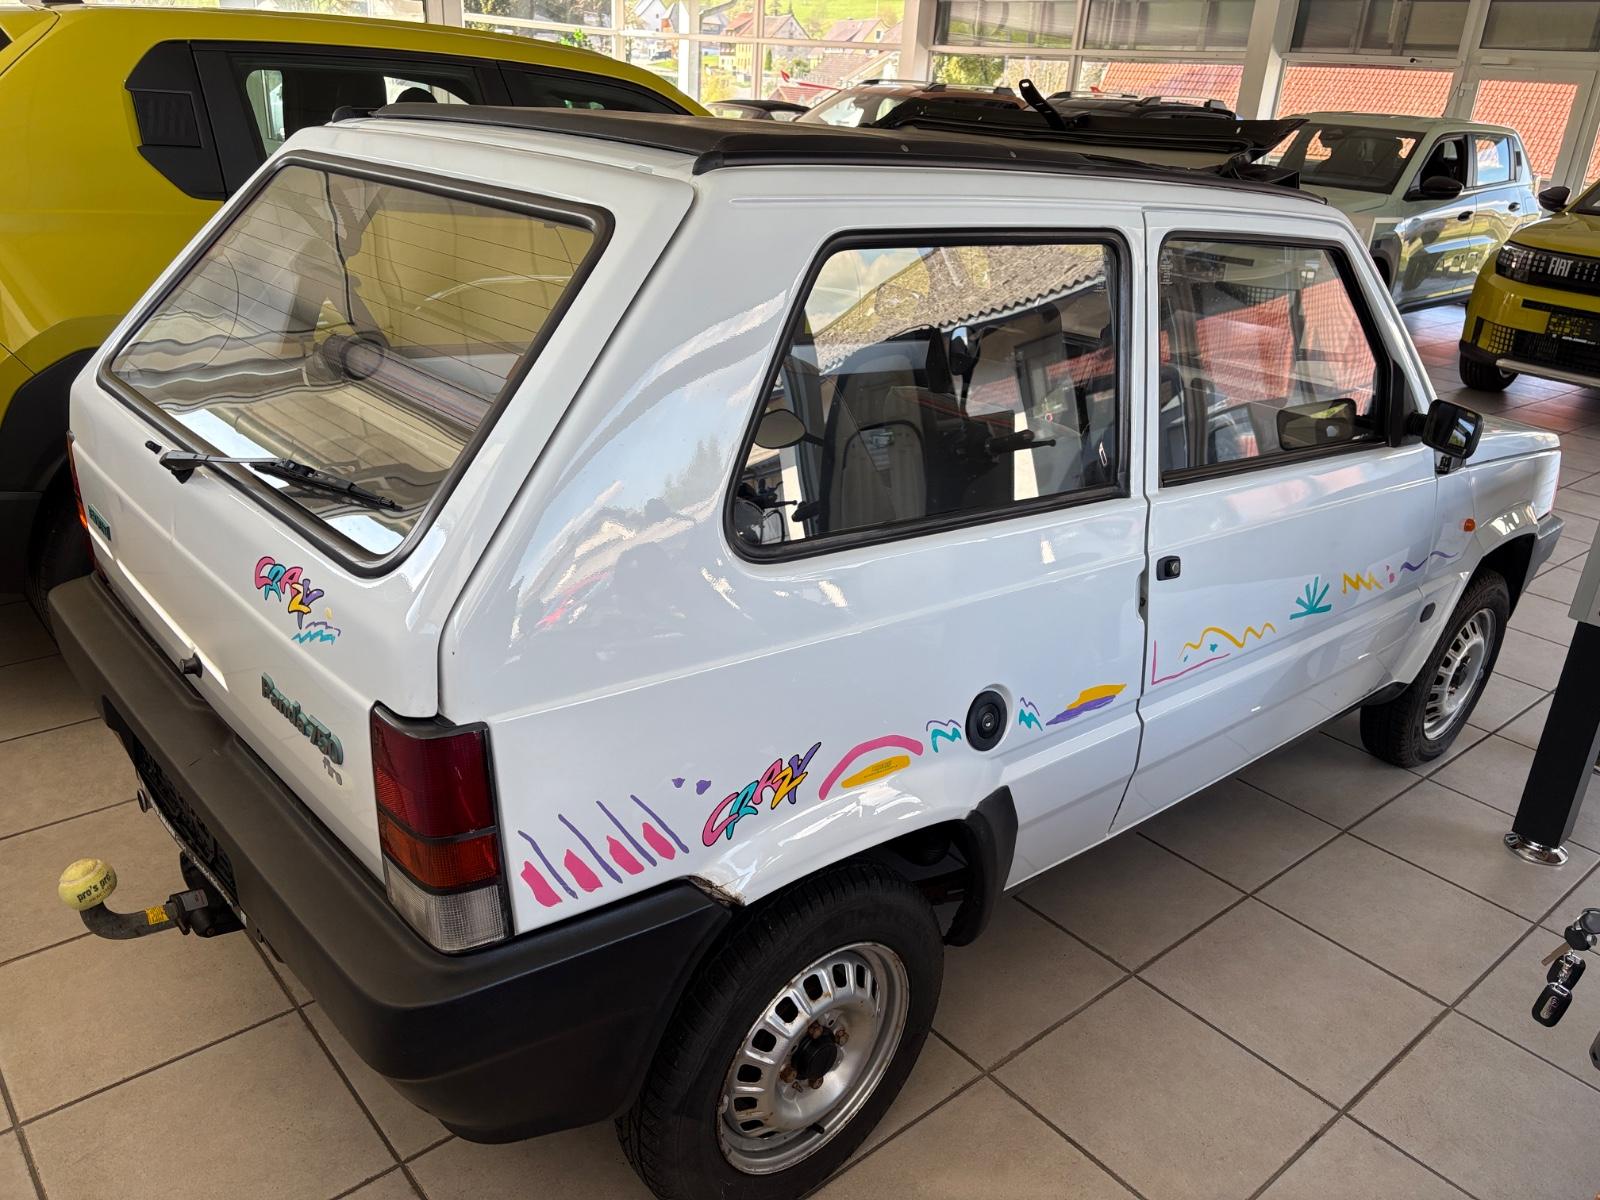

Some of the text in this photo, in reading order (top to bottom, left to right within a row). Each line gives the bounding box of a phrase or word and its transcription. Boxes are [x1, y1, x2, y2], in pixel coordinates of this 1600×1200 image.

[1547, 257, 1574, 277] FIAT
[254, 556, 325, 630] CRAZY
[261, 671, 311, 737] Panda
[702, 741, 822, 847] CRAZY
[77, 884, 99, 903] pro's
